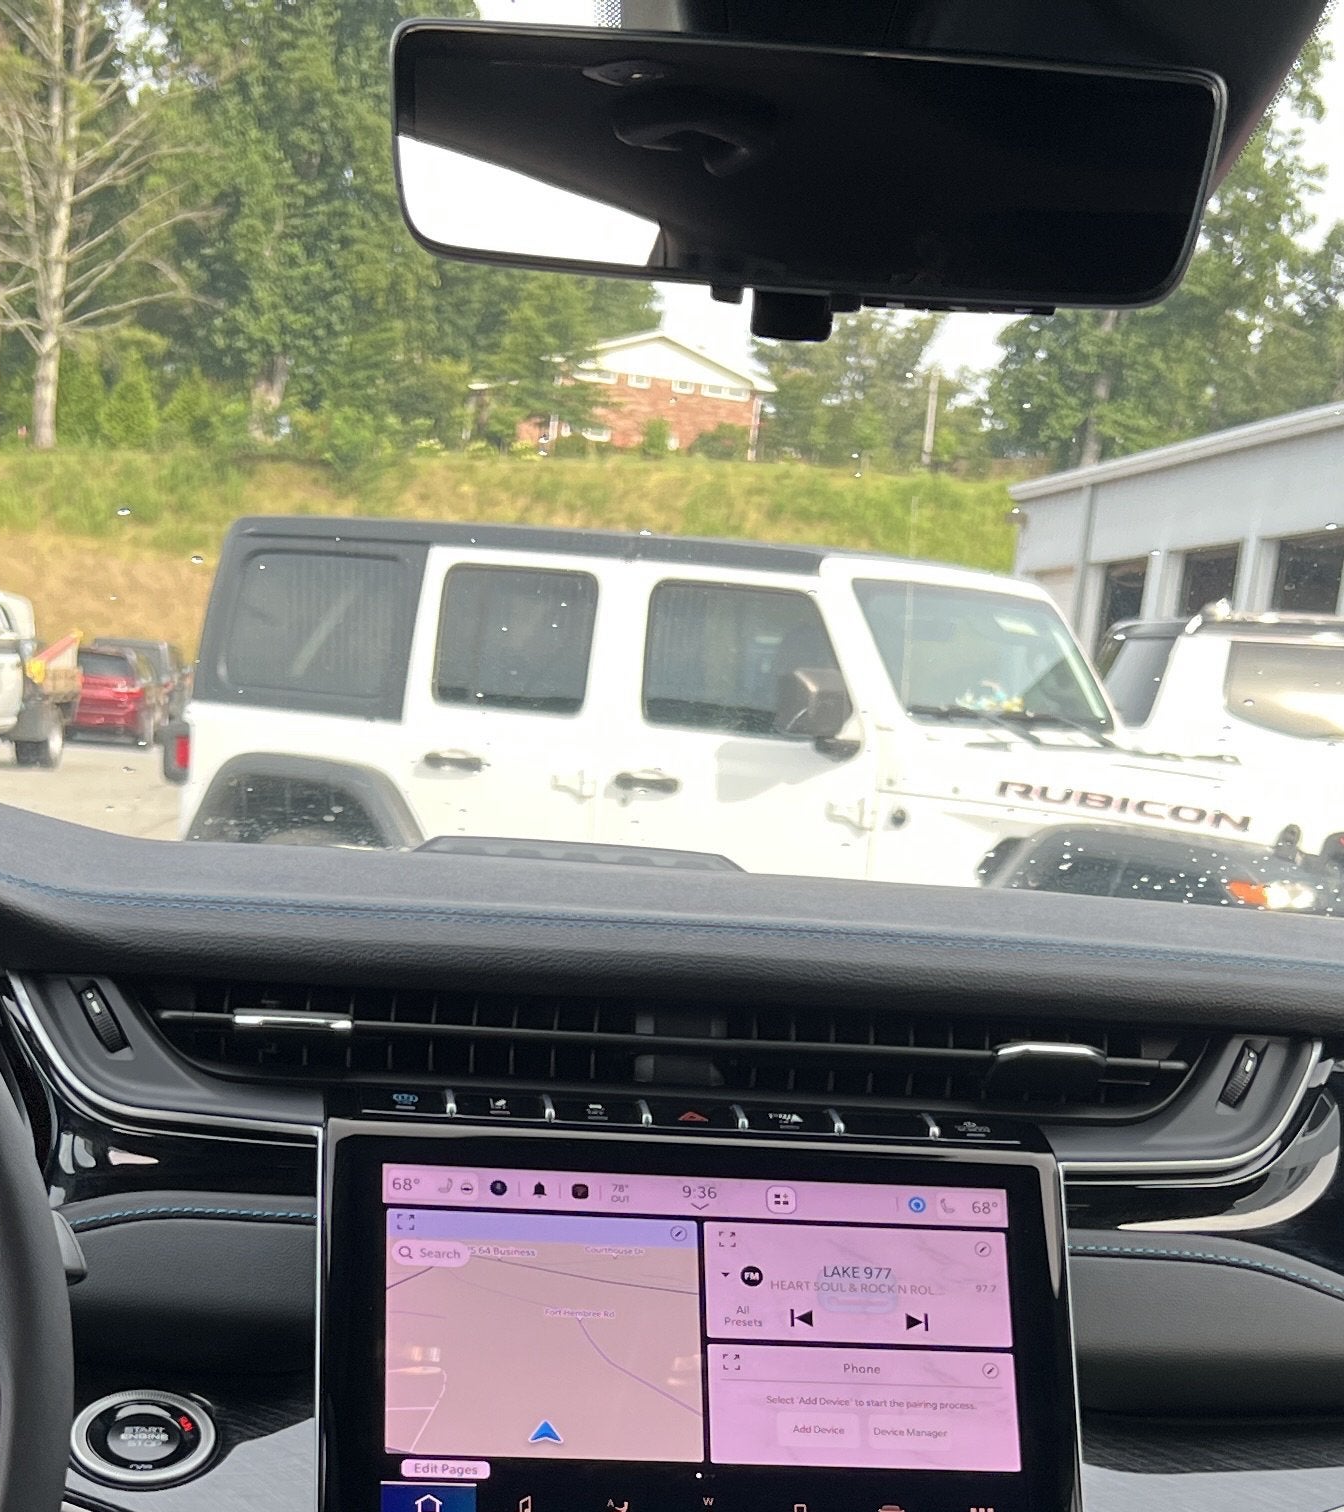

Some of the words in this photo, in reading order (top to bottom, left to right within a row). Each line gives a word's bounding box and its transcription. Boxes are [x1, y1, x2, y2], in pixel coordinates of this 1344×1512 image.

[996, 779, 1253, 833] RUBICON
[391, 1176, 421, 1192] 68°
[682, 1184, 718, 1200] 9:36
[971, 1201, 998, 1215] 68°
[419, 1247, 462, 1261] Search
[493, 1247, 536, 1257] Business
[743, 1271, 761, 1282] FM
[822, 1265, 861, 1280] LAKE
[862, 1266, 892, 1280] 977
[770, 1280, 811, 1293] HEART
[813, 1281, 847, 1293] SOUL
[859, 1283, 895, 1294] ROCK
[975, 1284, 997, 1294] 97.7
[736, 1305, 750, 1315] All
[724, 1317, 763, 1328] Presets
[843, 1363, 881, 1375] Phone
[766, 1395, 795, 1405] Select
[793, 1424, 812, 1434] Add
[813, 1425, 845, 1435] Device
[873, 1427, 905, 1437] Device
[906, 1428, 948, 1439] Manager
[414, 1463, 438, 1475] Edit
[441, 1464, 478, 1476] Pages
